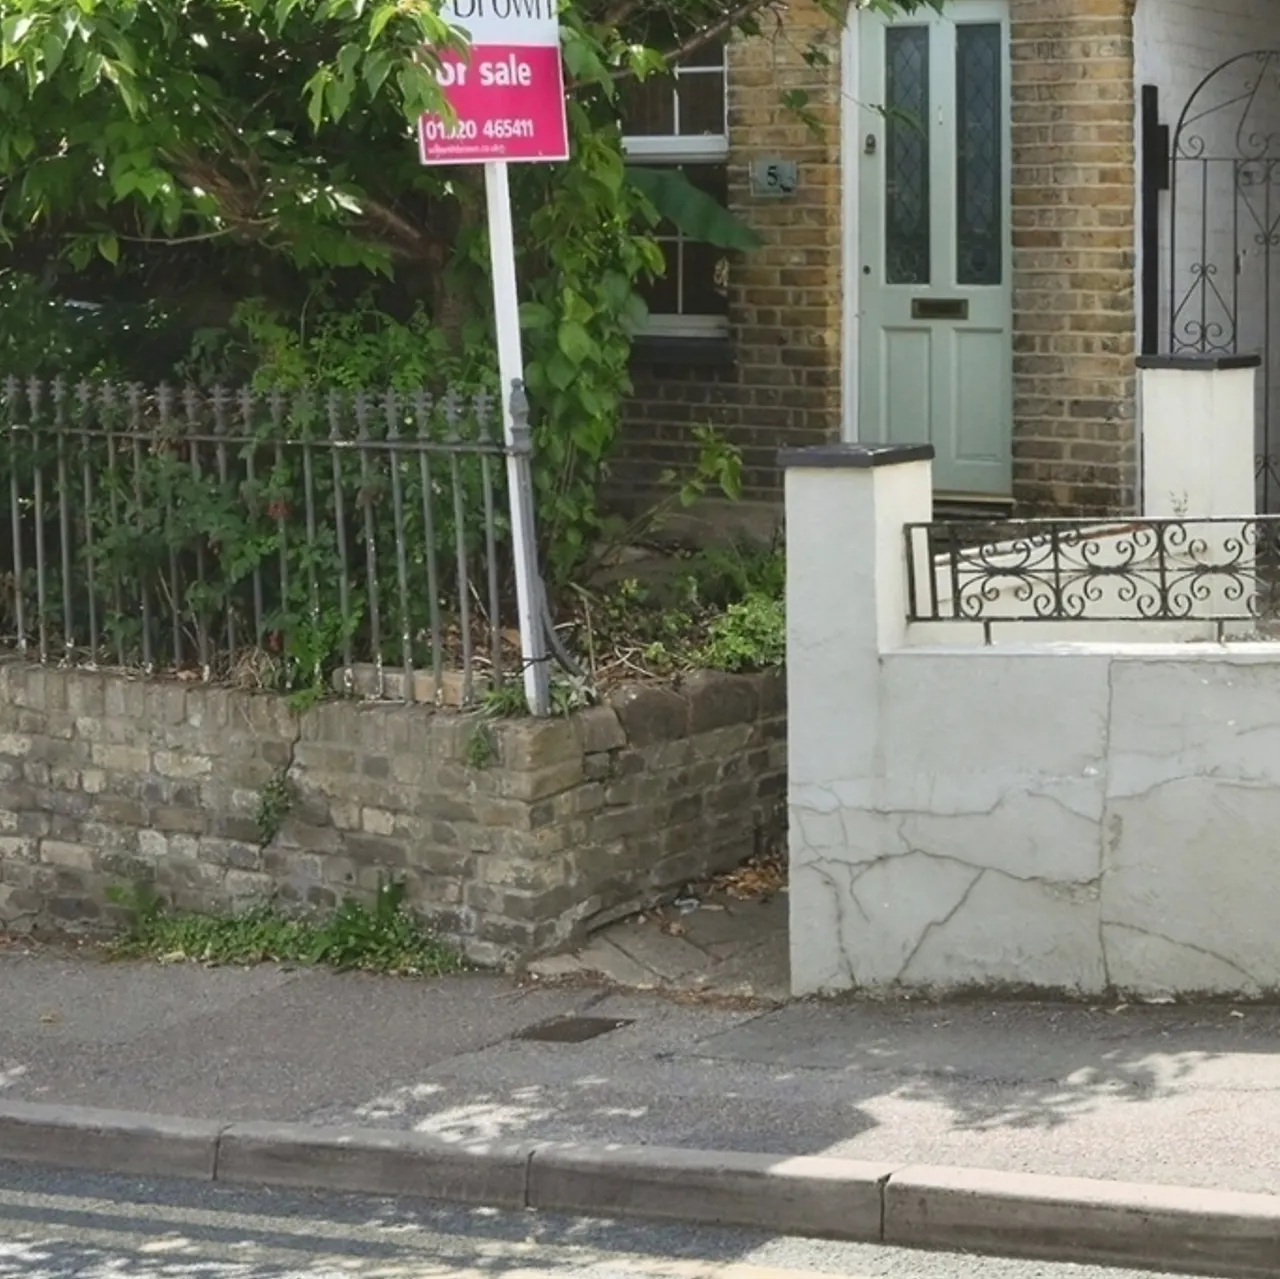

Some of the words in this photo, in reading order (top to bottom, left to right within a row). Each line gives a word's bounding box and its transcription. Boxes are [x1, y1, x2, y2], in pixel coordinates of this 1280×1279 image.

[435, 61, 467, 86] or
[479, 53, 532, 86] sale
[426, 120, 477, 141] 0120
[482, 119, 534, 139] 465411
[767, 165, 778, 187] 5
